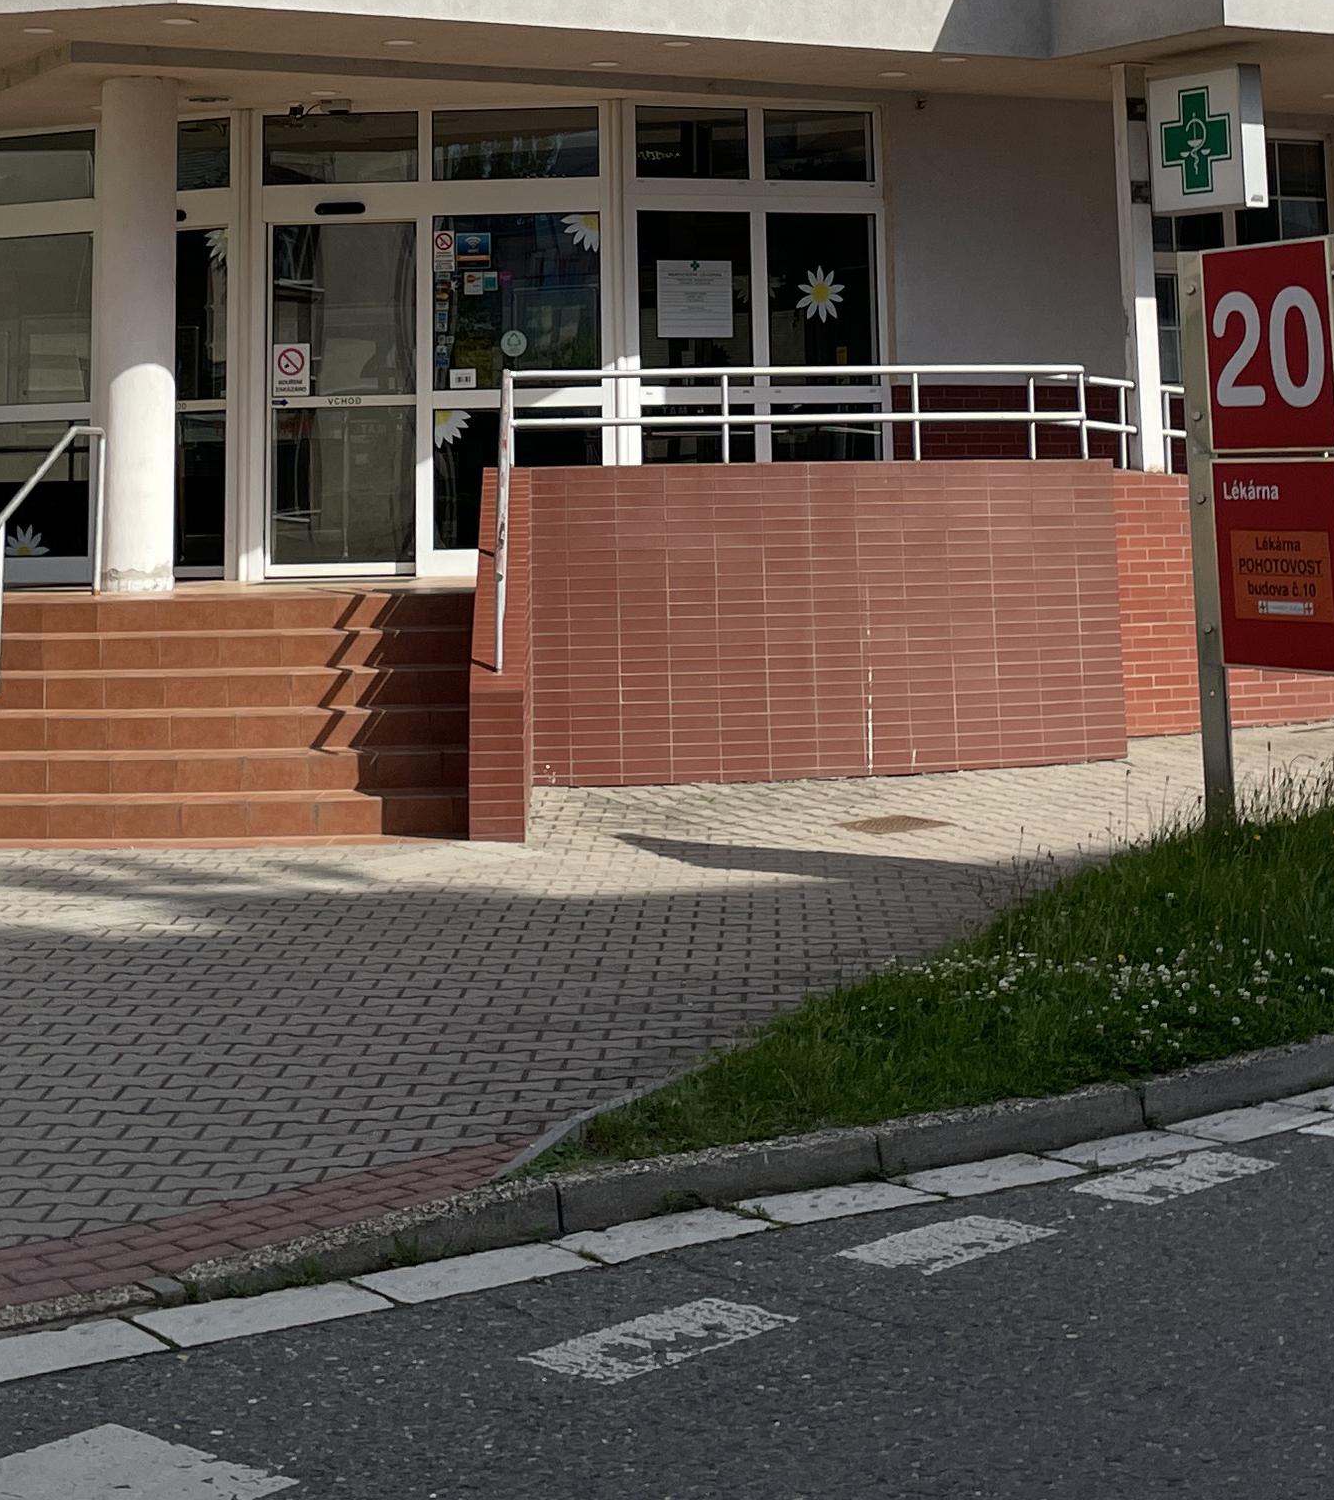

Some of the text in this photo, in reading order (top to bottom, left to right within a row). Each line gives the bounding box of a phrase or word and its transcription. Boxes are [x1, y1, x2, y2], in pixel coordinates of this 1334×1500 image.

[1213, 285, 1325, 408] 20
[328, 397, 362, 405] VCHOD
[1223, 479, 1279, 500] Lékárna
[1255, 536, 1301, 552] Lékárna
[1238, 557, 1322, 575] POHOTOVOST
[1247, 579, 1289, 597] budova
